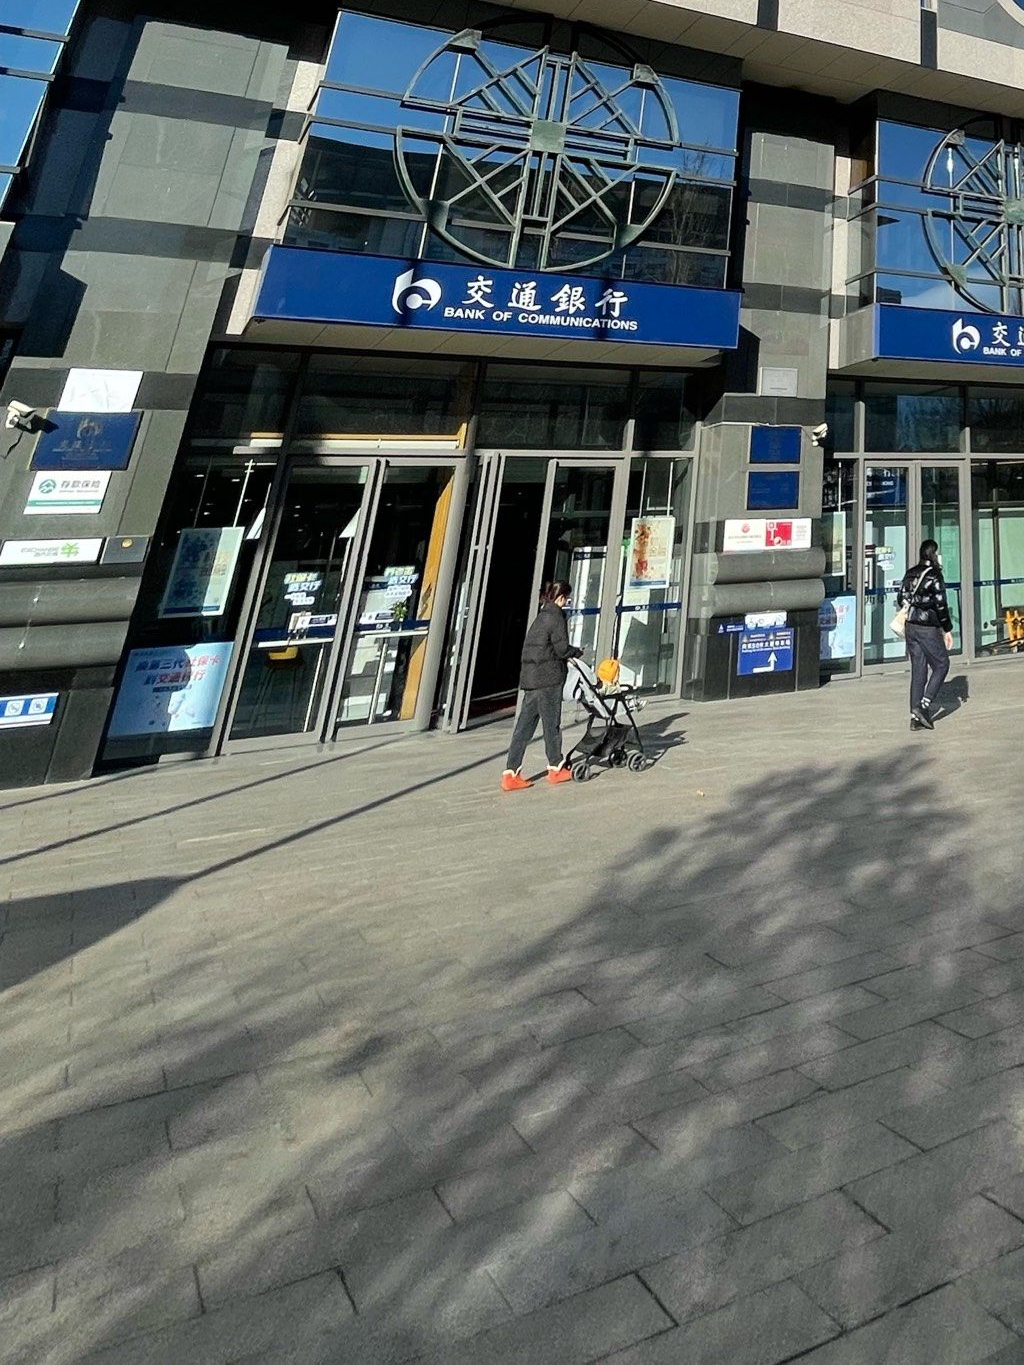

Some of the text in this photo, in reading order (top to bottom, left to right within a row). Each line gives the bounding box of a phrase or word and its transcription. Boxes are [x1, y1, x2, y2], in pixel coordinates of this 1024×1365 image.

[462, 275, 628, 318] 交通銀行
[443, 307, 638, 331] BANK OF COMMUNICATIONS
[982, 346, 1007, 356] BANK
[1010, 348, 1022, 357] OF
